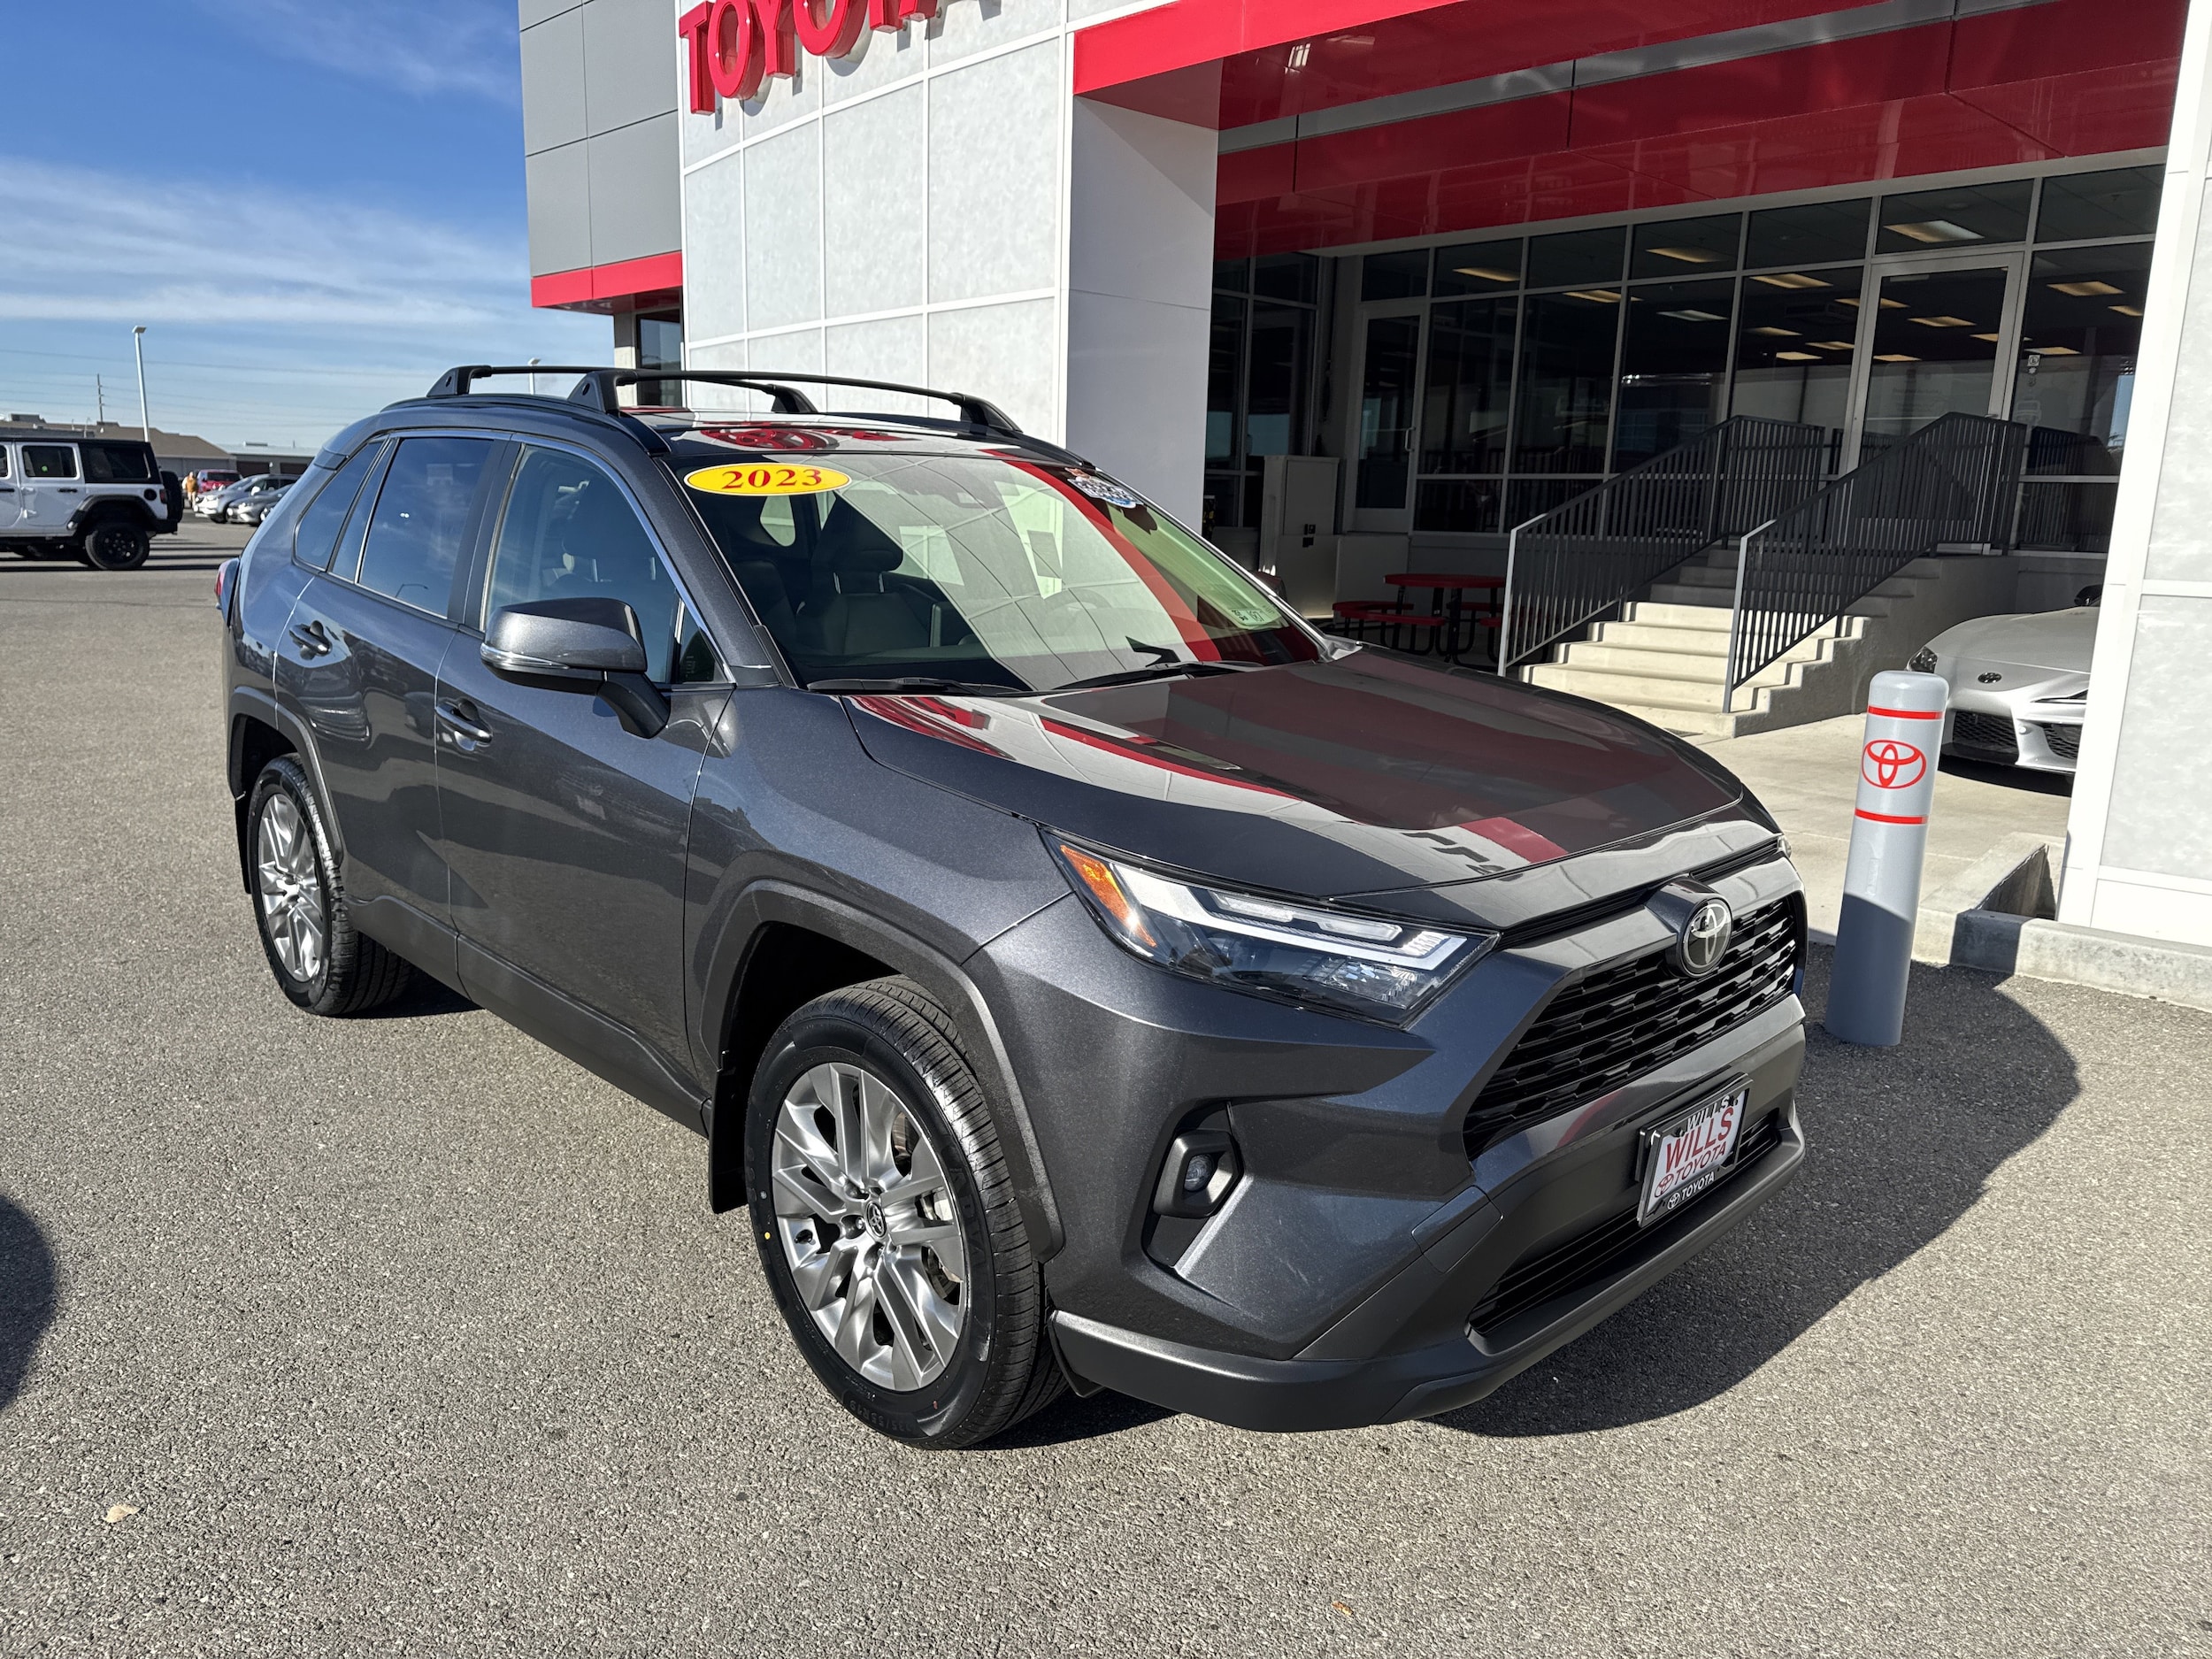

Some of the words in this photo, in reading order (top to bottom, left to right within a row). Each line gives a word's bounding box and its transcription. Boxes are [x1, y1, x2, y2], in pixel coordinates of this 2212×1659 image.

[679, 0, 937, 114] TOYO
[722, 469, 822, 489] 2023
[1687, 1095, 1730, 1131] WILLS
[1666, 1107, 1733, 1173] WILLS
[1675, 1141, 1726, 1185] TOYOTA
[1682, 1171, 1715, 1200] TOYOTA
